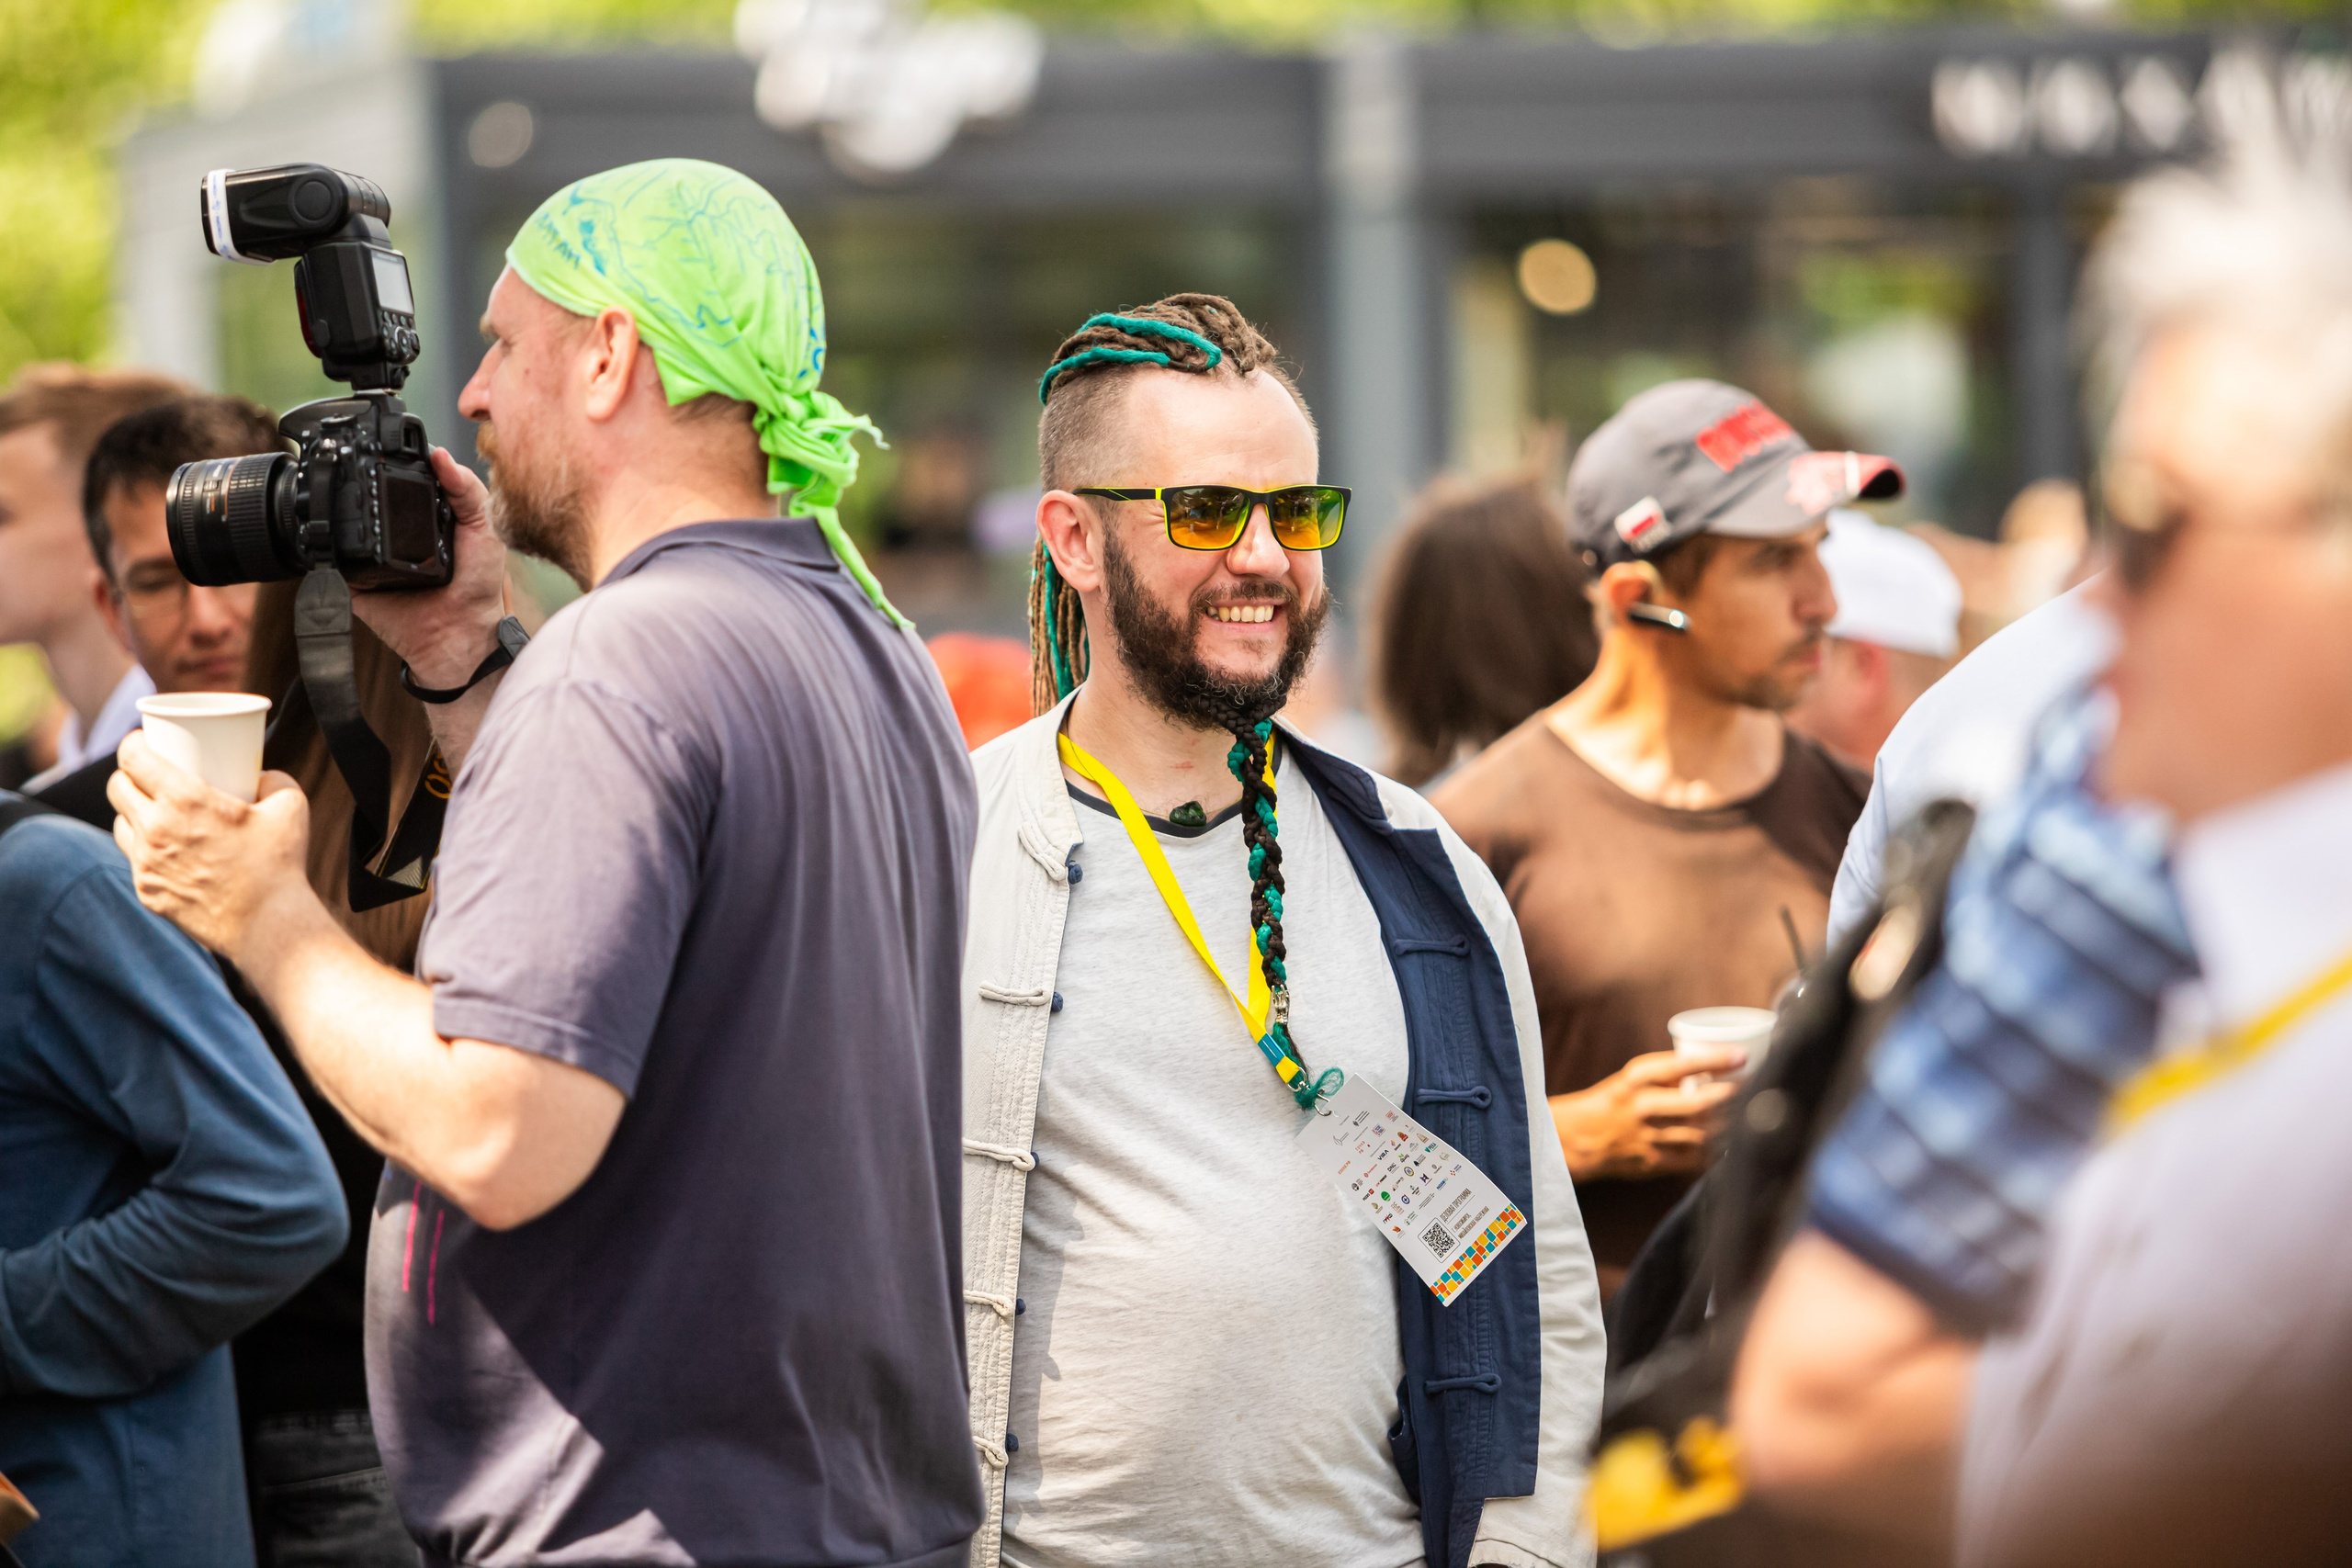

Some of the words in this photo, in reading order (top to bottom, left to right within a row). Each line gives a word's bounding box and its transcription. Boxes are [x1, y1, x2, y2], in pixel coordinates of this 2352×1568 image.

[1376, 1148, 1389, 1161] VIRA
[1439, 1203, 1456, 1224] ДЕЛОВАЯ
[1451, 1187, 1472, 1208] ПРОГРАММА
